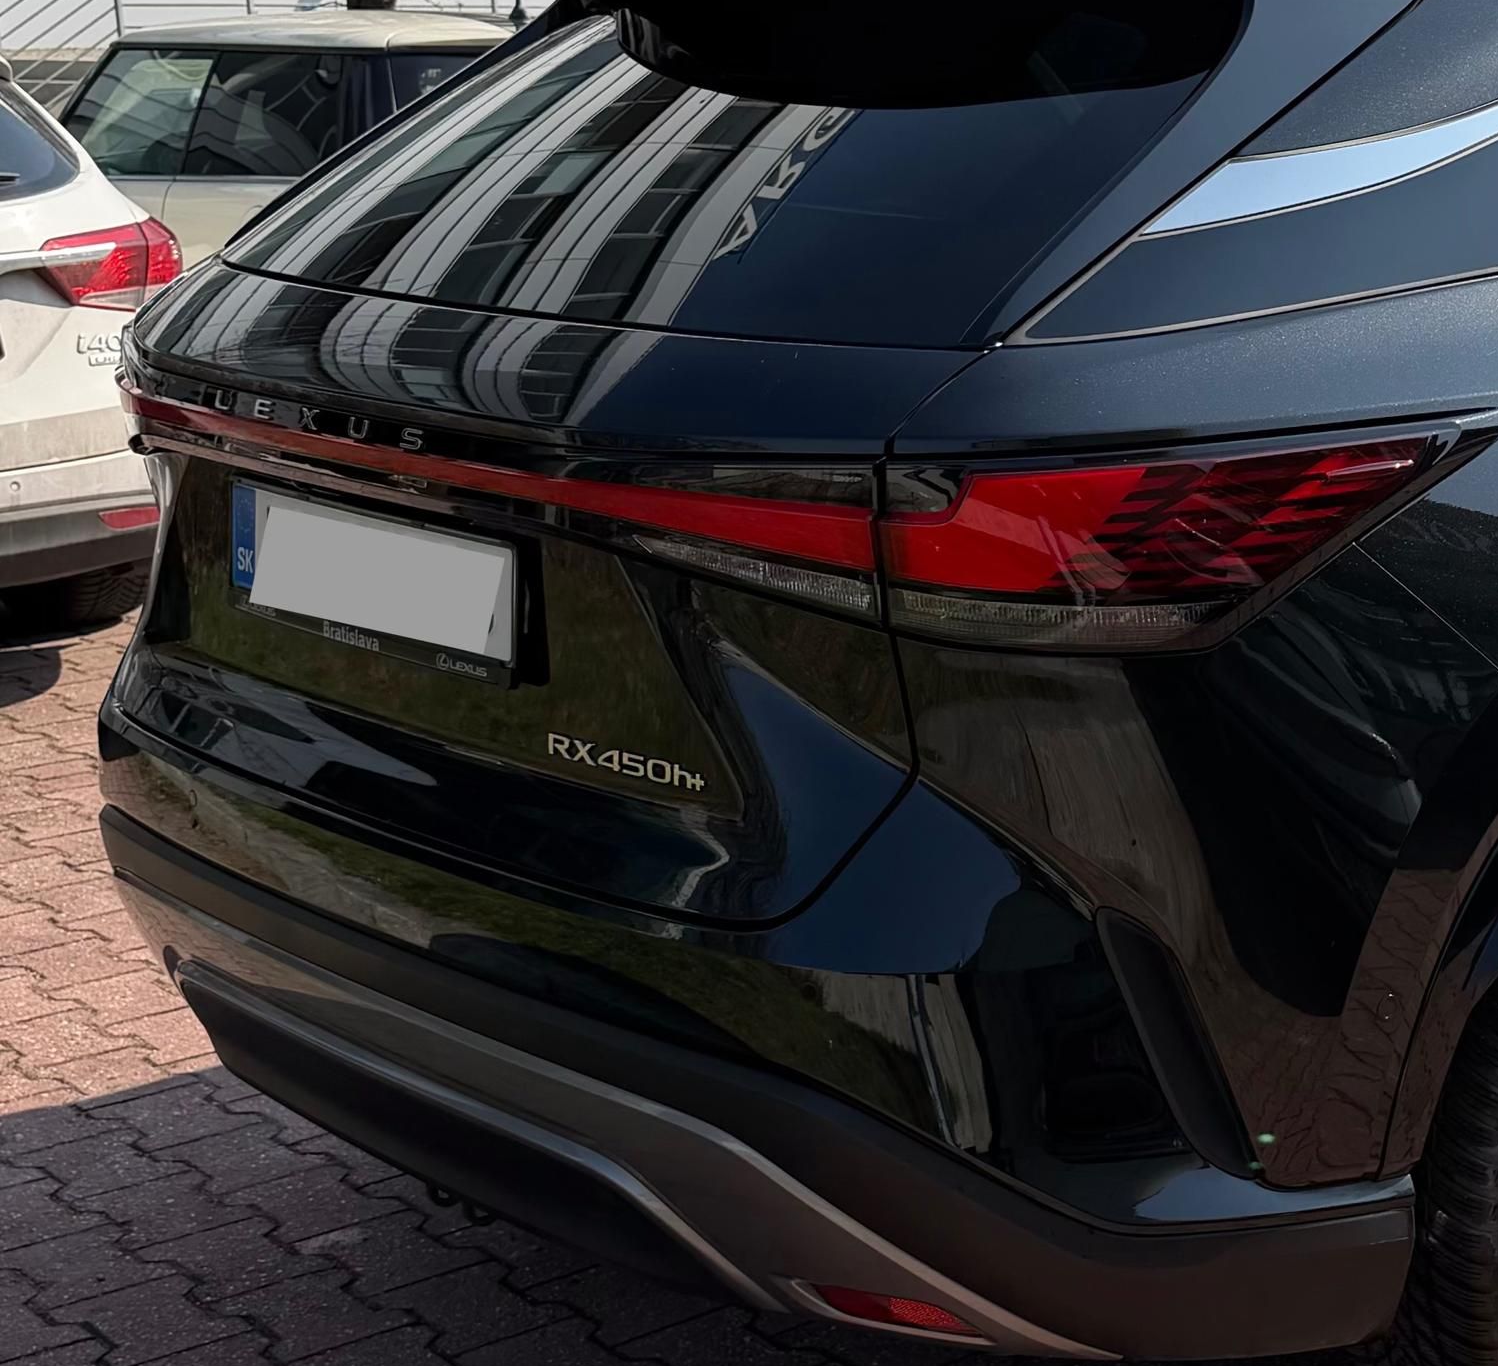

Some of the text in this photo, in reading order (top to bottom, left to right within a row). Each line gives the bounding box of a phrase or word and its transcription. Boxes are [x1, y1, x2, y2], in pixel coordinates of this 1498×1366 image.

[213, 389, 425, 450] LEXUS
[237, 546, 254, 573] SK
[322, 620, 380, 652] Bratislava
[450, 659, 488, 677] LEXUS
[547, 732, 705, 792] RX450h+
